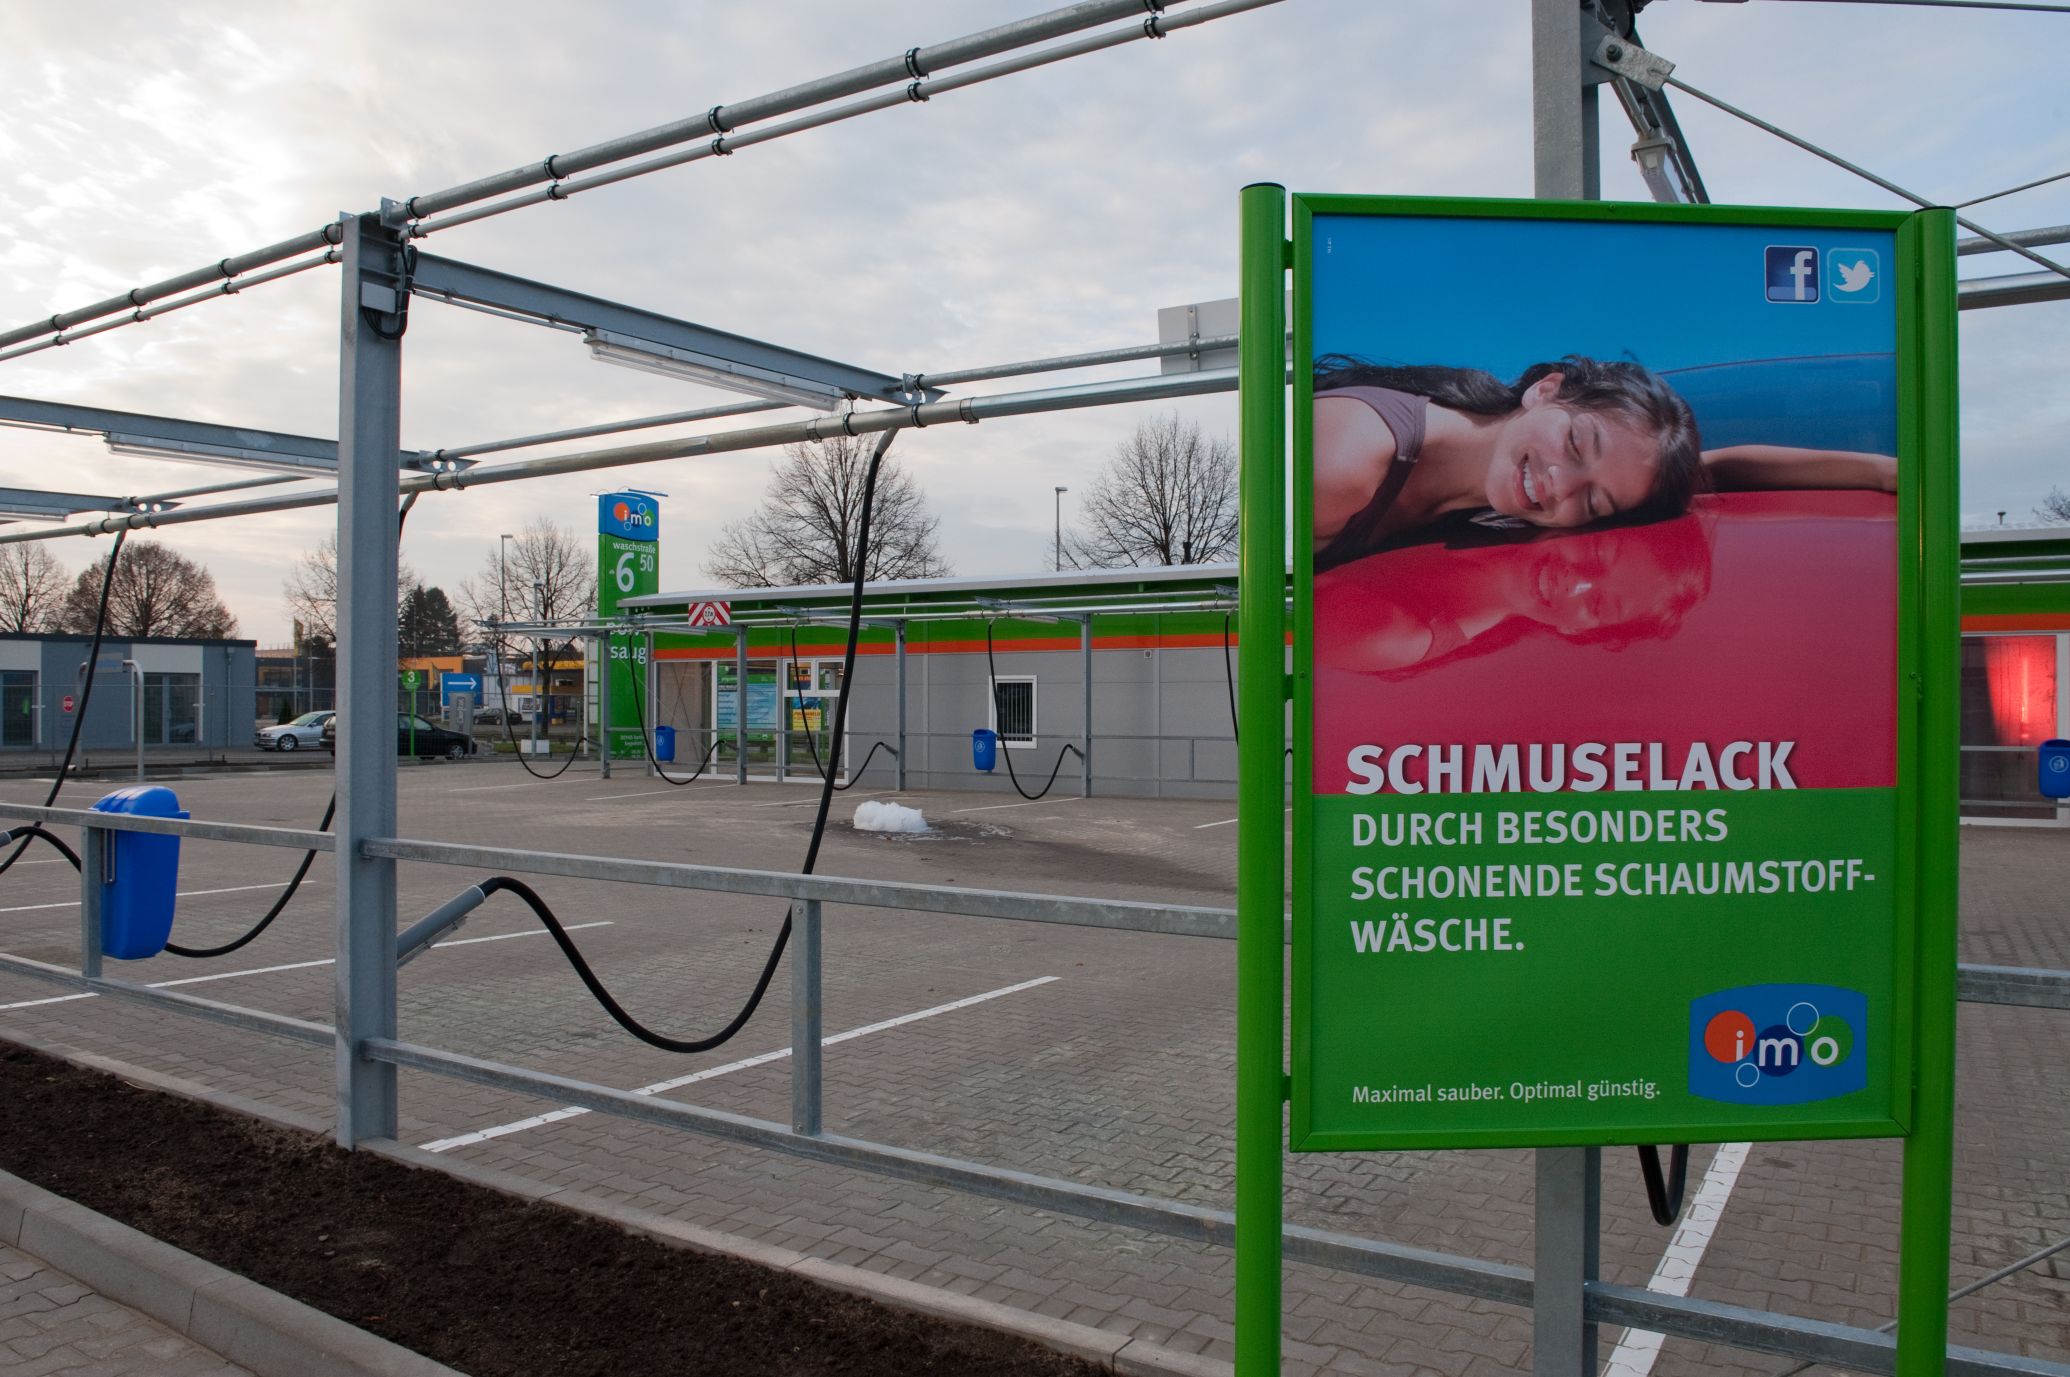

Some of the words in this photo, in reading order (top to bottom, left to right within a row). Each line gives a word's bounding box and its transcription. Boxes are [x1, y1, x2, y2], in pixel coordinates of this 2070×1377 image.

[623, 510, 652, 526] imo
[612, 542, 656, 553] waschstraße
[616, 552, 635, 593] 6
[639, 554, 654, 573] 50
[408, 671, 415, 682] 3
[1345, 740, 1799, 795] SCHMUSELACK
[1351, 812, 1483, 847] DURCH
[1497, 808, 1729, 845] BESONDERS
[1350, 863, 1584, 901] SCHONENDE
[1594, 858, 1876, 897] SCHAUMSTOFF-
[1350, 913, 1526, 954] WÄSCHE.
[1735, 1030, 1840, 1068] imo
[1352, 1084, 1433, 1104] Maximal
[1436, 1082, 1505, 1102] sauber.
[1509, 1080, 1583, 1103] Optimal
[1587, 1078, 1662, 1103] günstig.
